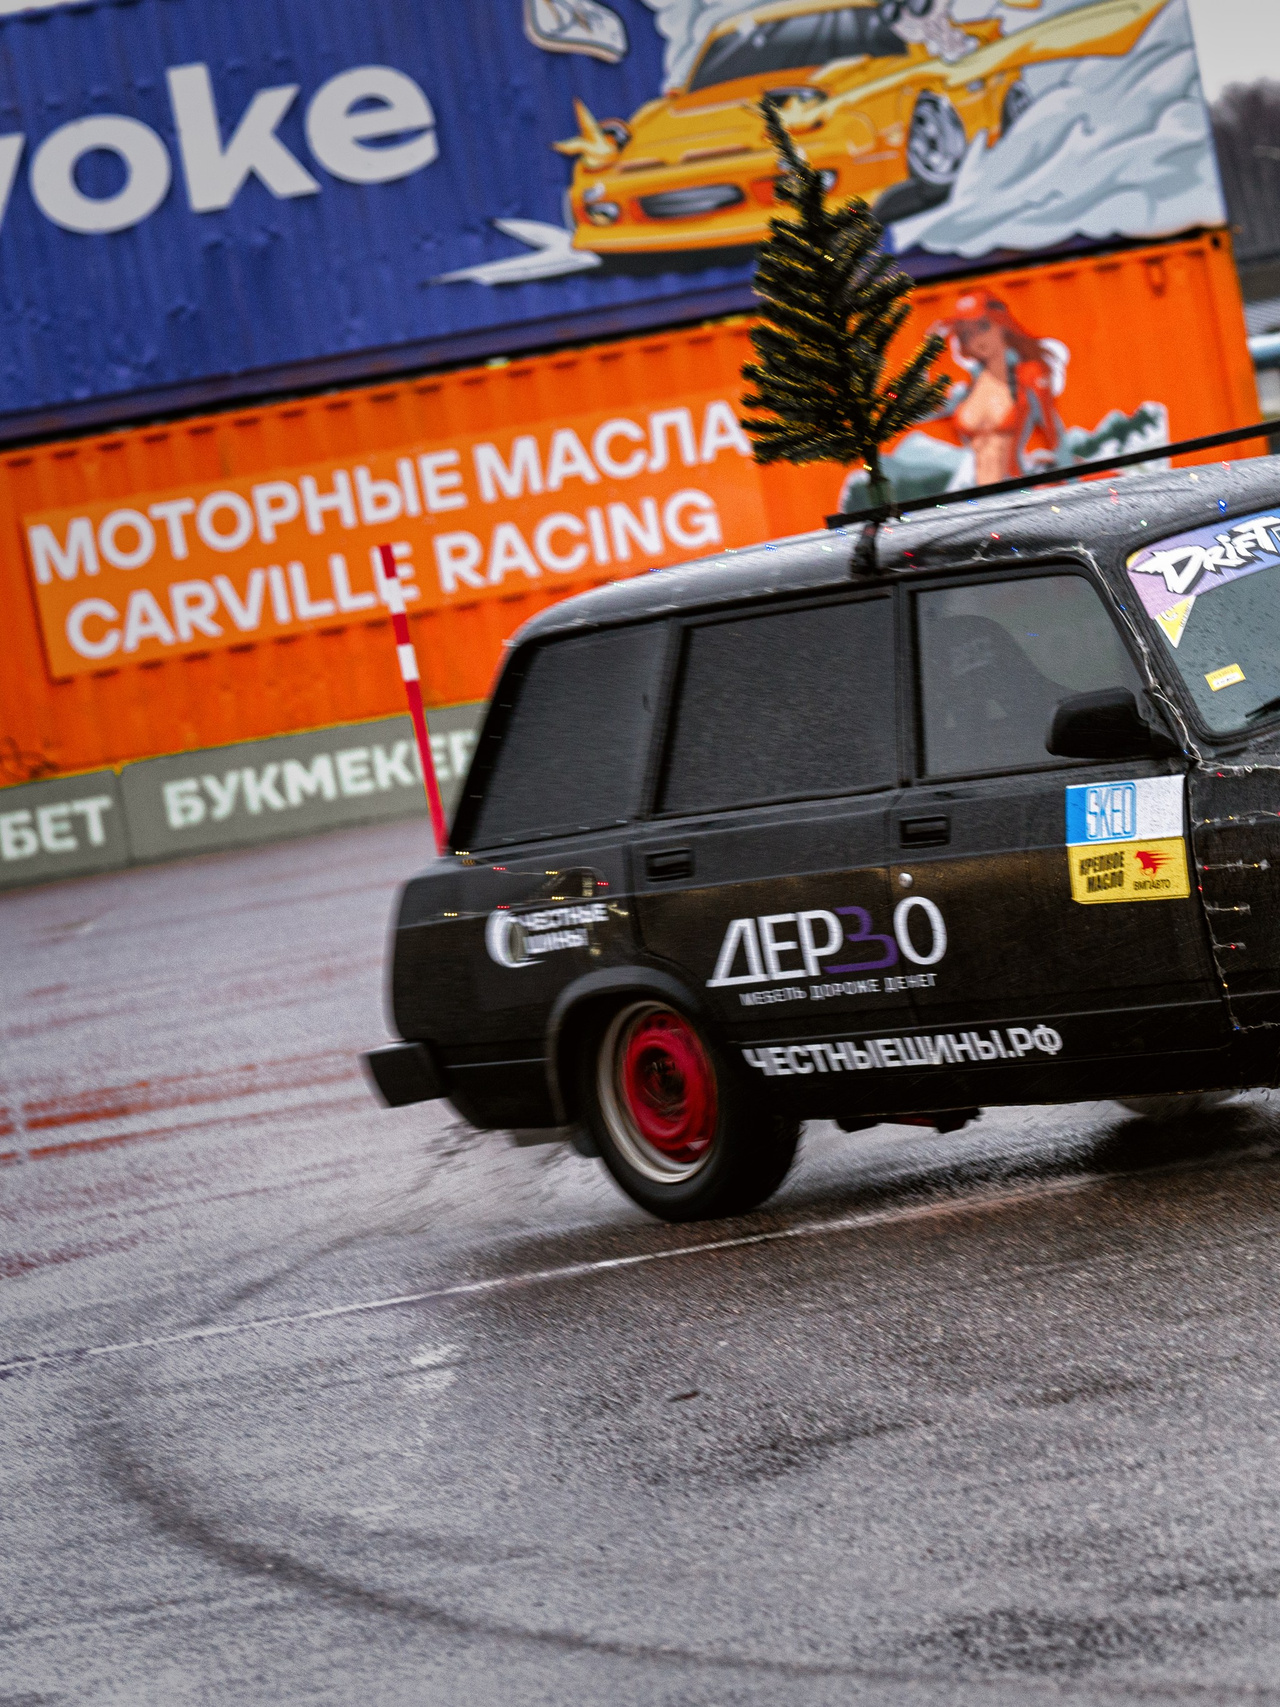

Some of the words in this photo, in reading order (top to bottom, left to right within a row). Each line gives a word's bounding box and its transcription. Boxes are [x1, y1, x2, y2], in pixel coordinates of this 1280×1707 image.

[28, 449, 468, 585] МОТОРНЫЕ
[473, 400, 753, 503] МАСЛА
[65, 541, 420, 659] CARVILLE
[433, 487, 721, 593] RACING
[705, 895, 948, 988] ДЕРЗО
[809, 978, 881, 1001] ДОРОЖЕ
[884, 973, 938, 993] ДЕНЕГ
[741, 1023, 1063, 1076] ЧЕСТНЫЕШИНЫ.РФ
